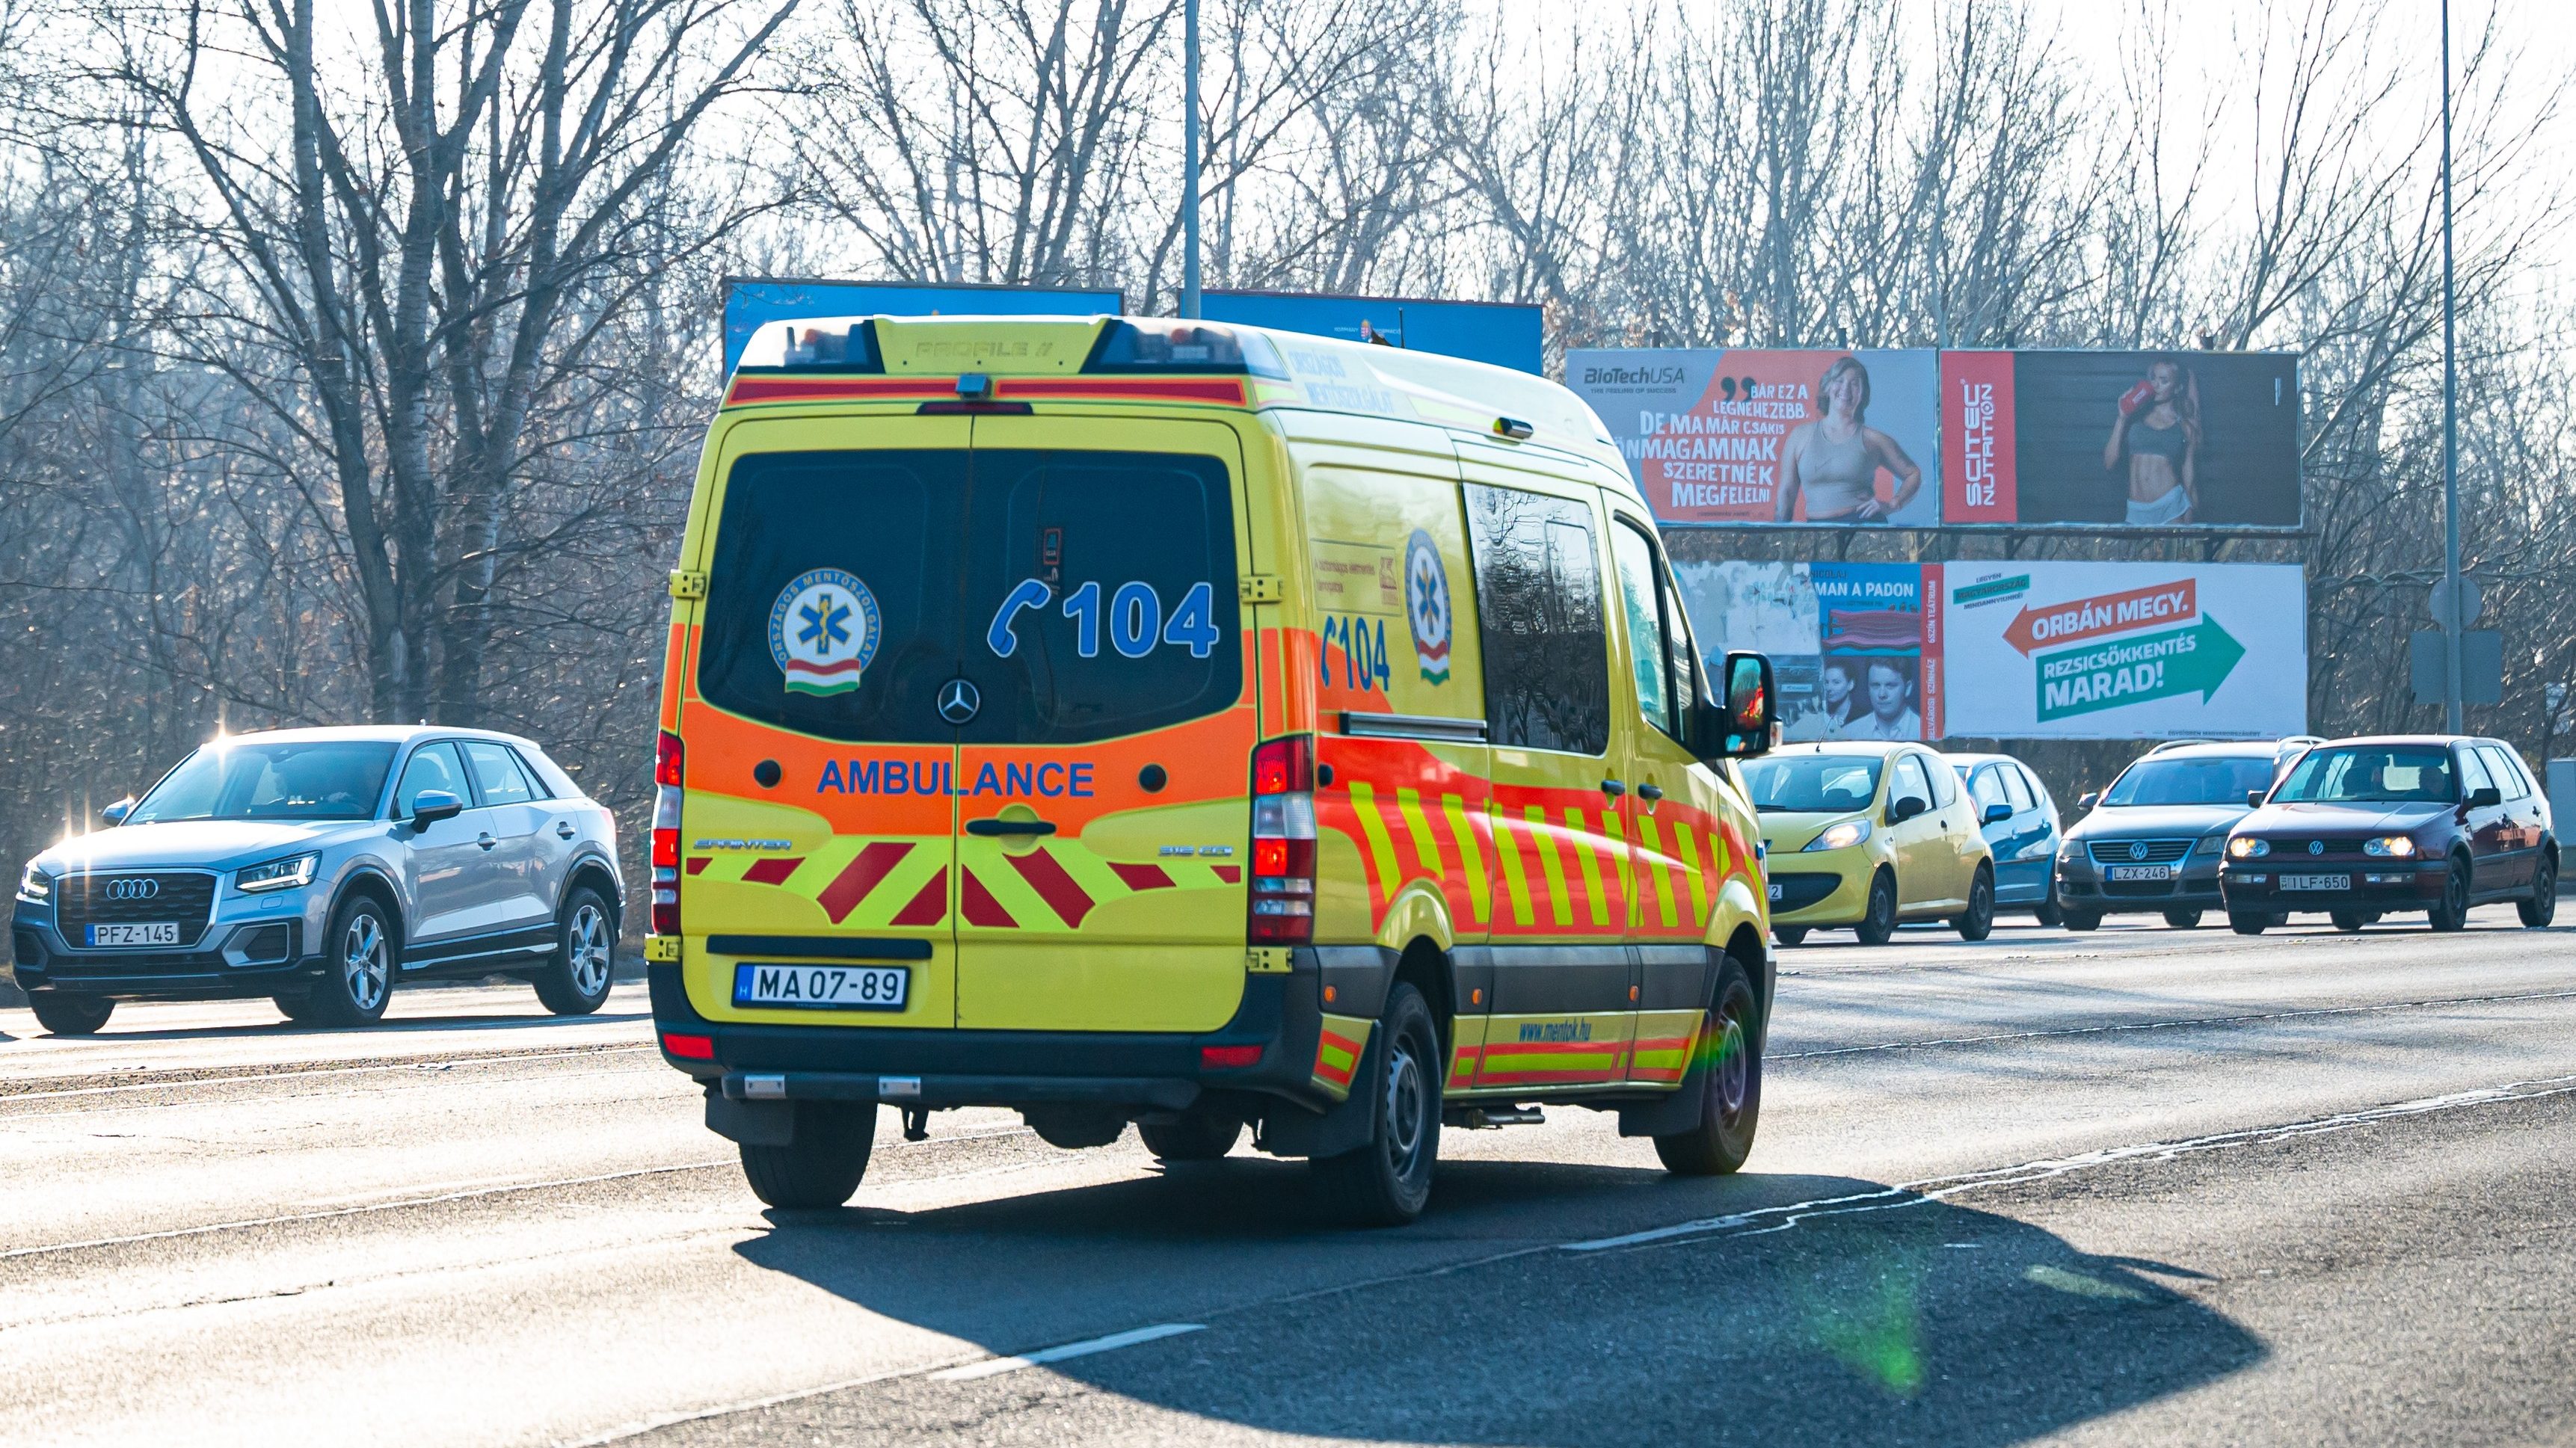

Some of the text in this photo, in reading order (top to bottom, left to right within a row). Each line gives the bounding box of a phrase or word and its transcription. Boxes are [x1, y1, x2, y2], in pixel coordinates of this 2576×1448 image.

[1584, 366, 1685, 384] BioTechUSA
[1750, 382, 1809, 400] BÁR EZ A
[1640, 410, 1785, 436] DE MA MÁR CSAKIS
[1981, 383, 1996, 506] NUTRITION
[1662, 461, 1774, 486] SZERETNÉK
[1671, 482, 1771, 508] MEGFELELNI
[1851, 582, 1862, 597] A
[1865, 582, 1914, 597] PADON
[771, 585, 800, 662] ORSZÁGOS
[1063, 581, 1220, 659] 104
[2032, 590, 2189, 641] ORBÁN MEGY.
[1338, 615, 1390, 692] 104
[2044, 632, 2197, 680] REZSICSÖKKENTÉS
[2045, 660, 2165, 710] MARAD!
[817, 759, 1095, 798] AMBULANCE
[2114, 867, 2166, 880] LZX-246
[2293, 876, 2348, 890] ILF-650
[97, 925, 174, 943] PFZ-145
[758, 969, 801, 999] MA
[809, 970, 899, 1001] 07-89
